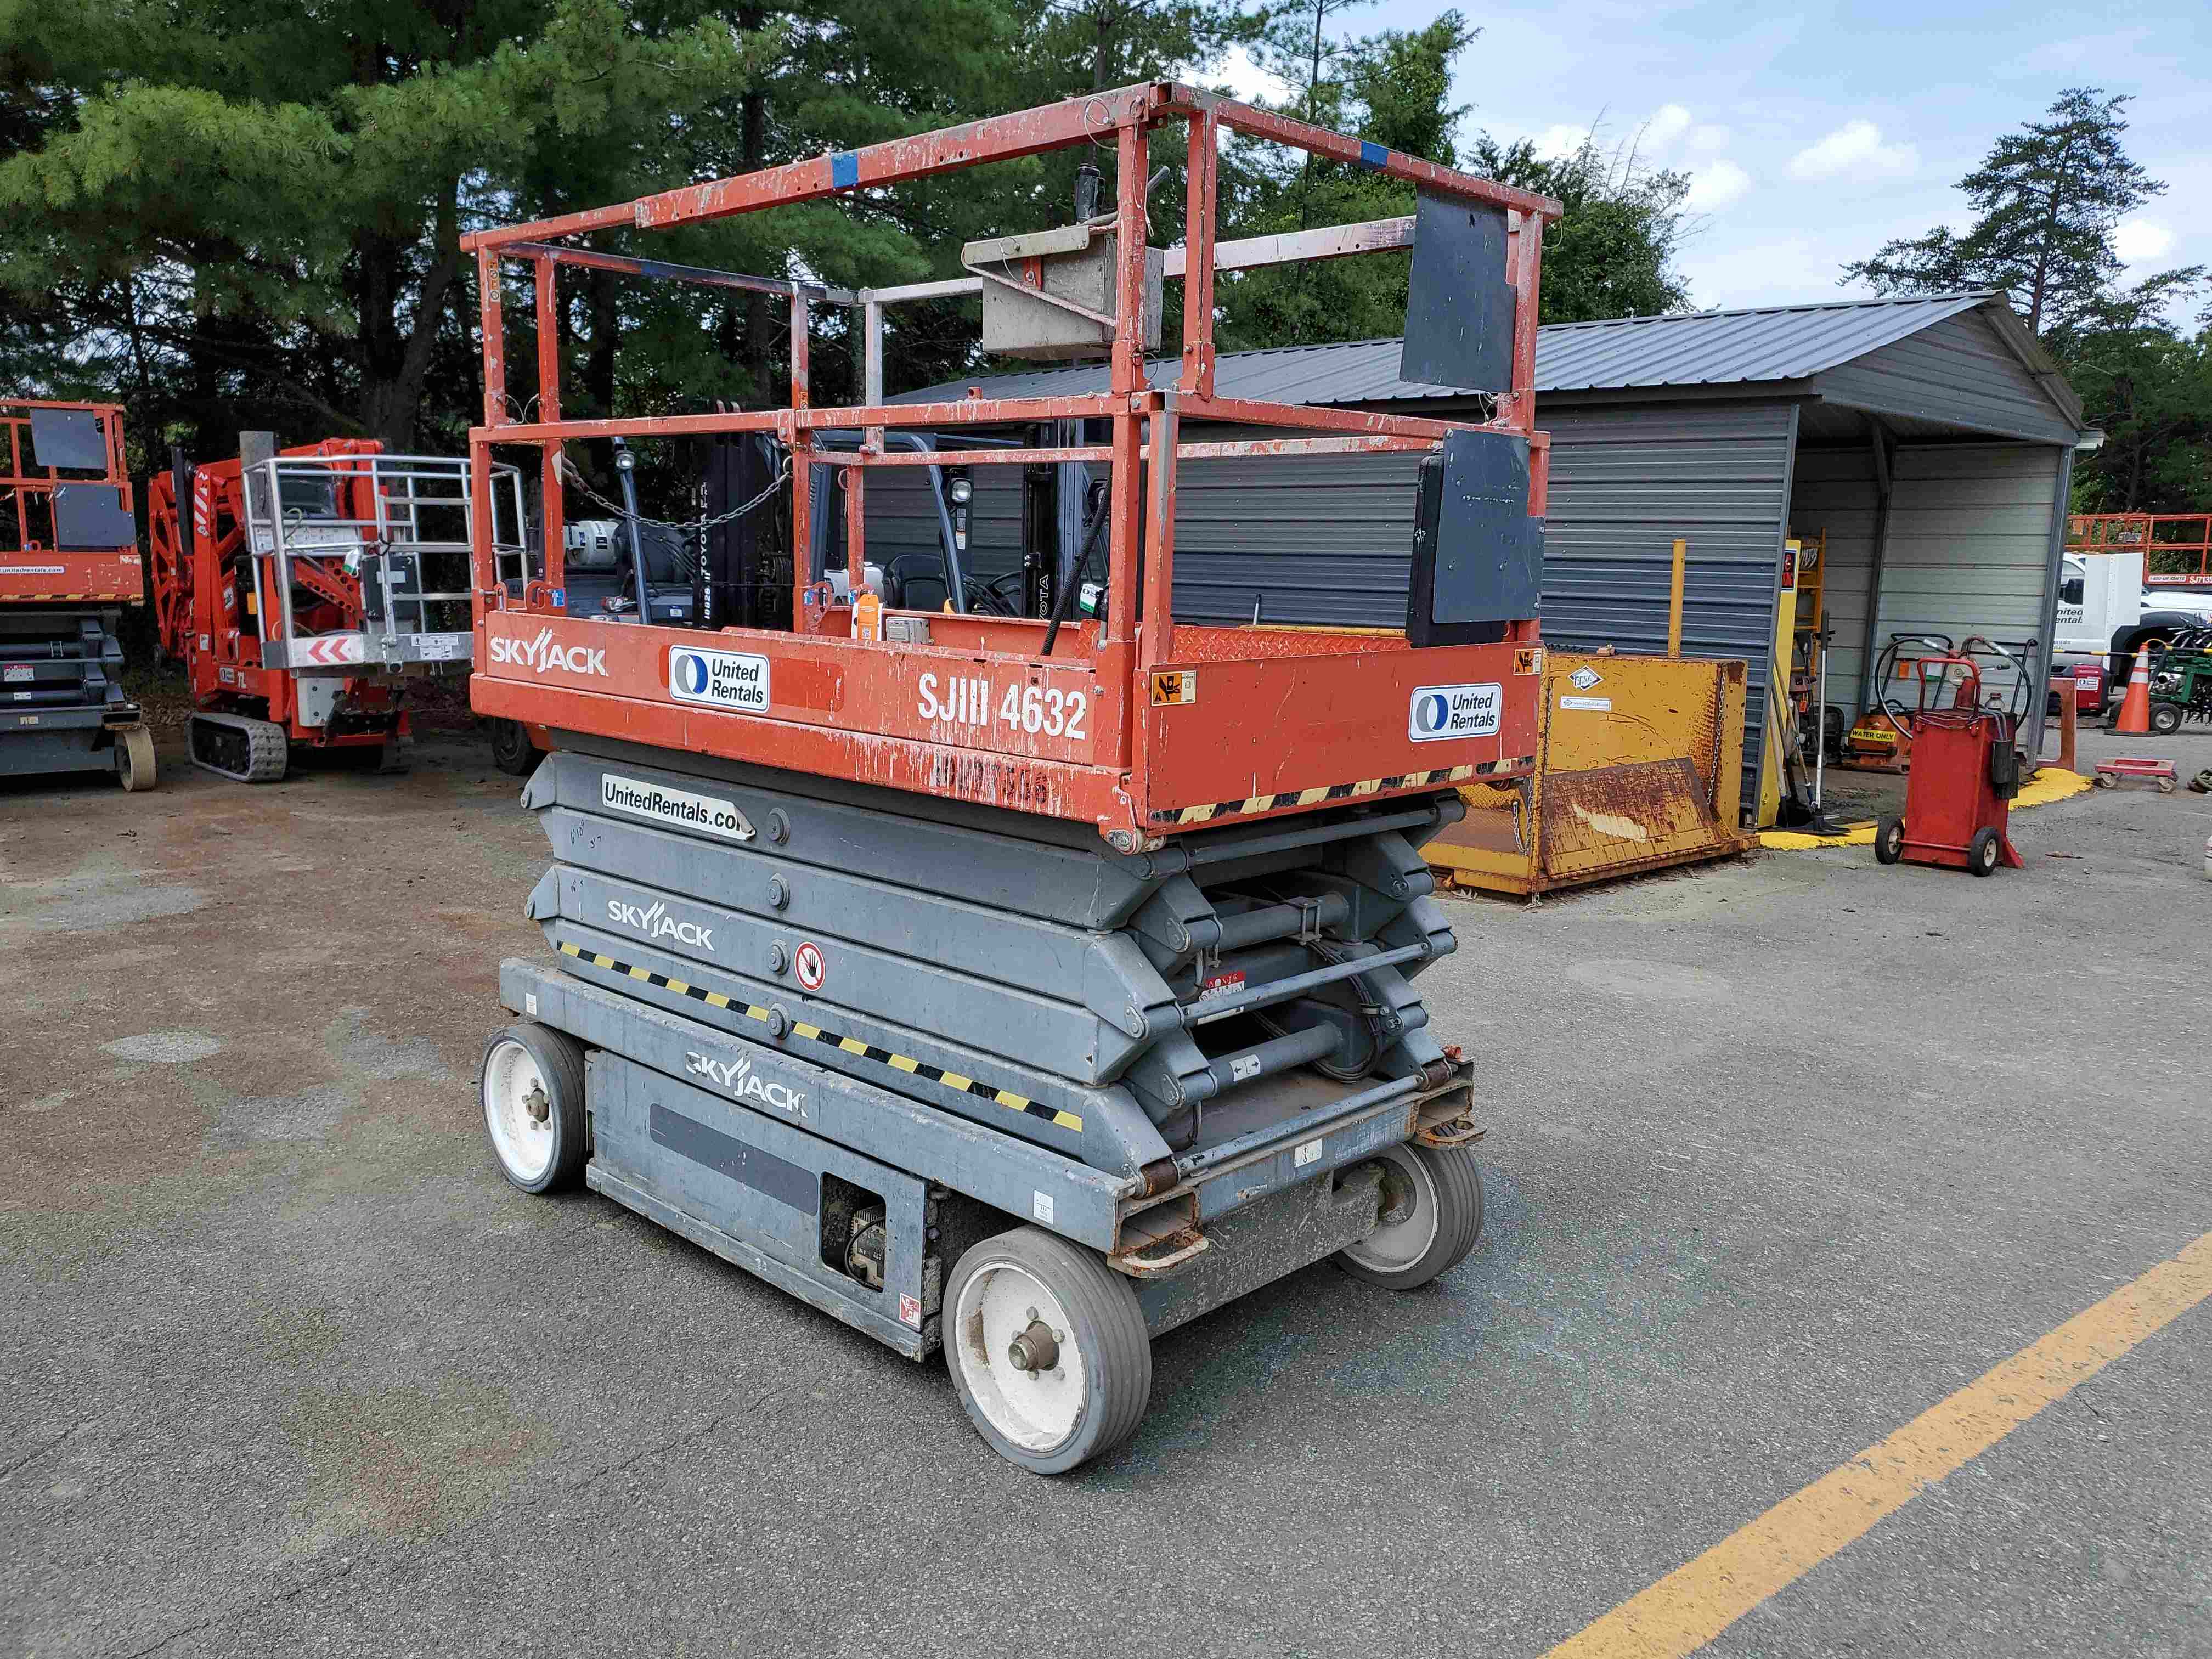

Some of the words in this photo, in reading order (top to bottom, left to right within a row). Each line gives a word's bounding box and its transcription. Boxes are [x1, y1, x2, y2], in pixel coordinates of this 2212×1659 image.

[490, 625, 609, 677] SKYJACK
[712, 658, 760, 682] United
[711, 679, 764, 704] Rentals
[918, 673, 989, 726] SJIII
[1000, 684, 1087, 741] 4632
[1452, 692, 1494, 711] United
[1450, 710, 1496, 730] Rentals
[1852, 730, 1875, 738] WATER
[605, 781, 742, 832] UnitedRentals.co
[607, 900, 716, 952] SKYJACK
[686, 1051, 809, 1119] SKYJACK
